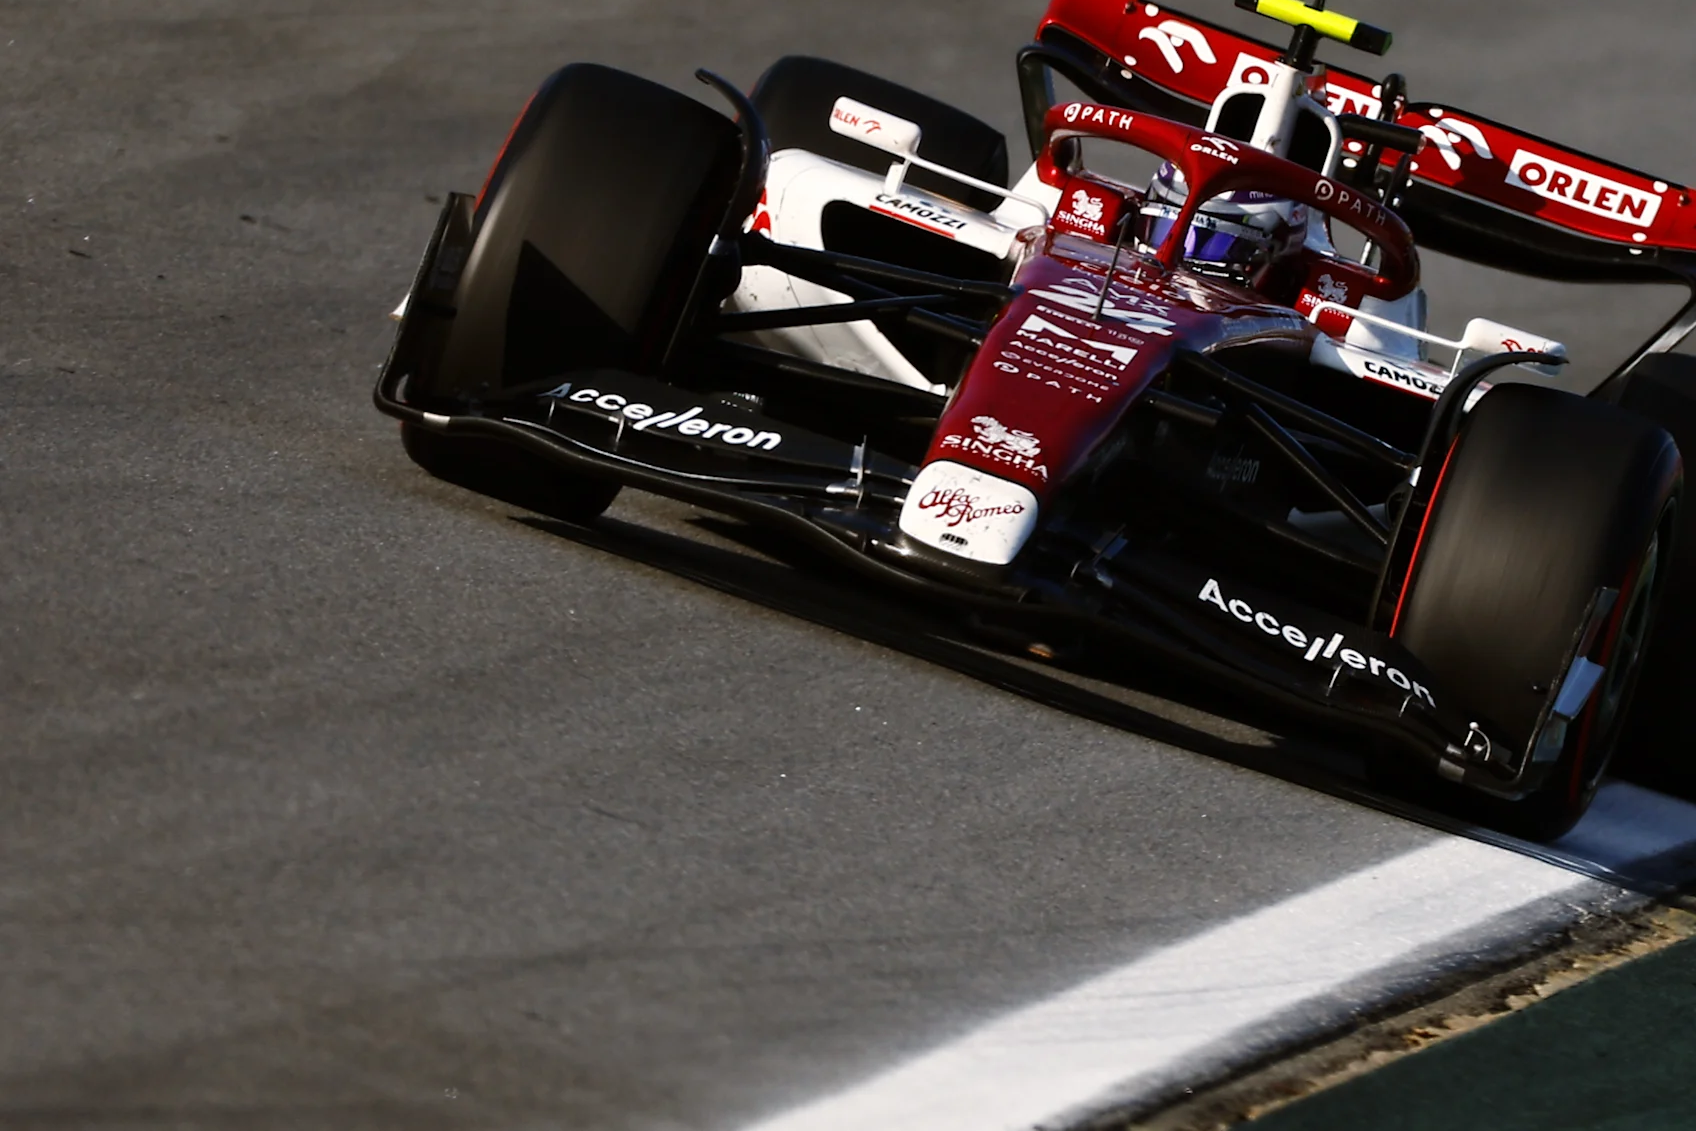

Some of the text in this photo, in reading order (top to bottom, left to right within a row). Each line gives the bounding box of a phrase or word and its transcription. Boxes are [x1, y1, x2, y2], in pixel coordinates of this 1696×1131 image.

[1081, 106, 1133, 130] PATH
[1190, 143, 1239, 165] ORLEN
[1337, 190, 1387, 226] PATH
[1518, 162, 1648, 219] ORLEN
[875, 193, 968, 230] CAMOZZI
[1057, 210, 1105, 233] SINGHA
[1028, 284, 1177, 336] 24
[1009, 340, 1118, 381] Accelleron
[1016, 329, 1127, 371] MARELLI
[1026, 372, 1102, 403] PATH
[537, 382, 782, 450] Accelleron
[942, 434, 1048, 479] SINGHA
[919, 486, 1025, 527] Alfa Romeo
[1199, 578, 1437, 709] Accelleron
